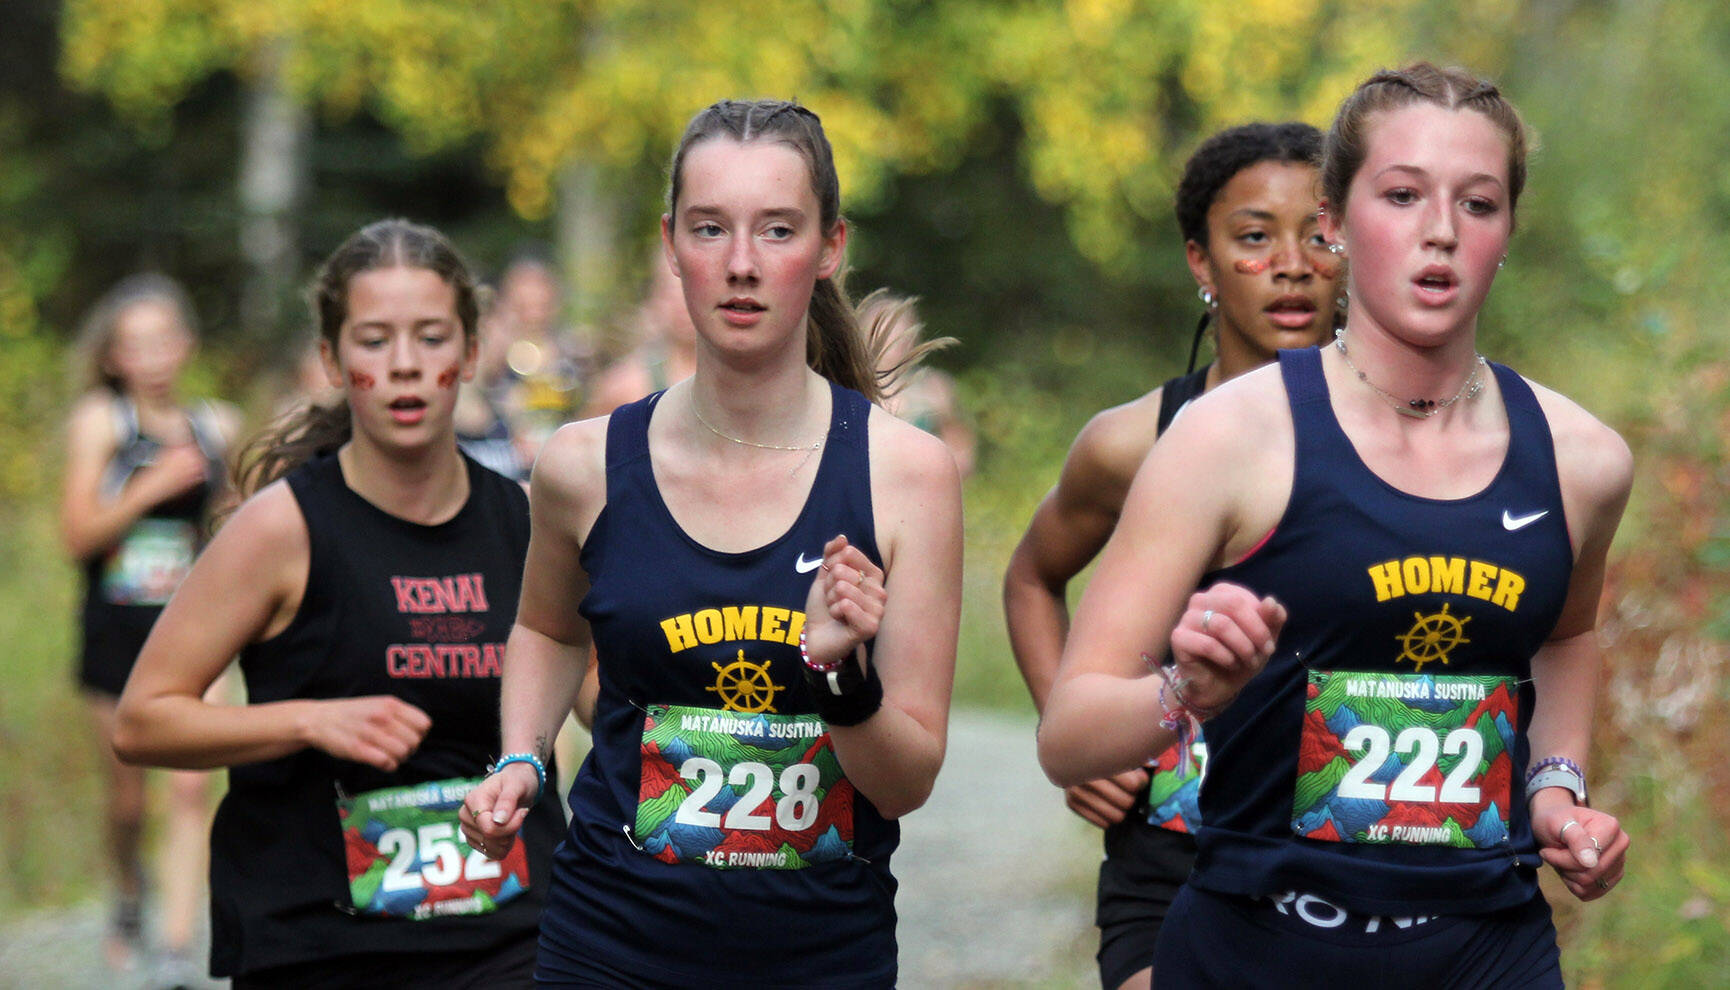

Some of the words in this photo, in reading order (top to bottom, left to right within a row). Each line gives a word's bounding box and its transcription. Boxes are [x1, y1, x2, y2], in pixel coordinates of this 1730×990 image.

[390, 572, 489, 613] KENAI
[1367, 556, 1526, 612] HOMER
[1346, 680, 1430, 699] MATANUSKA
[1434, 683, 1486, 700] SUSITNA
[681, 715, 764, 737] MATANUSKA
[769, 721, 823, 739] SUSITNA
[1337, 725, 1484, 803] 222
[675, 757, 821, 831] 228
[1367, 824, 1389, 841] XC
[1391, 826, 1452, 843] RUNNING
[705, 850, 724, 866] XC
[728, 851, 787, 867] RUNNING
